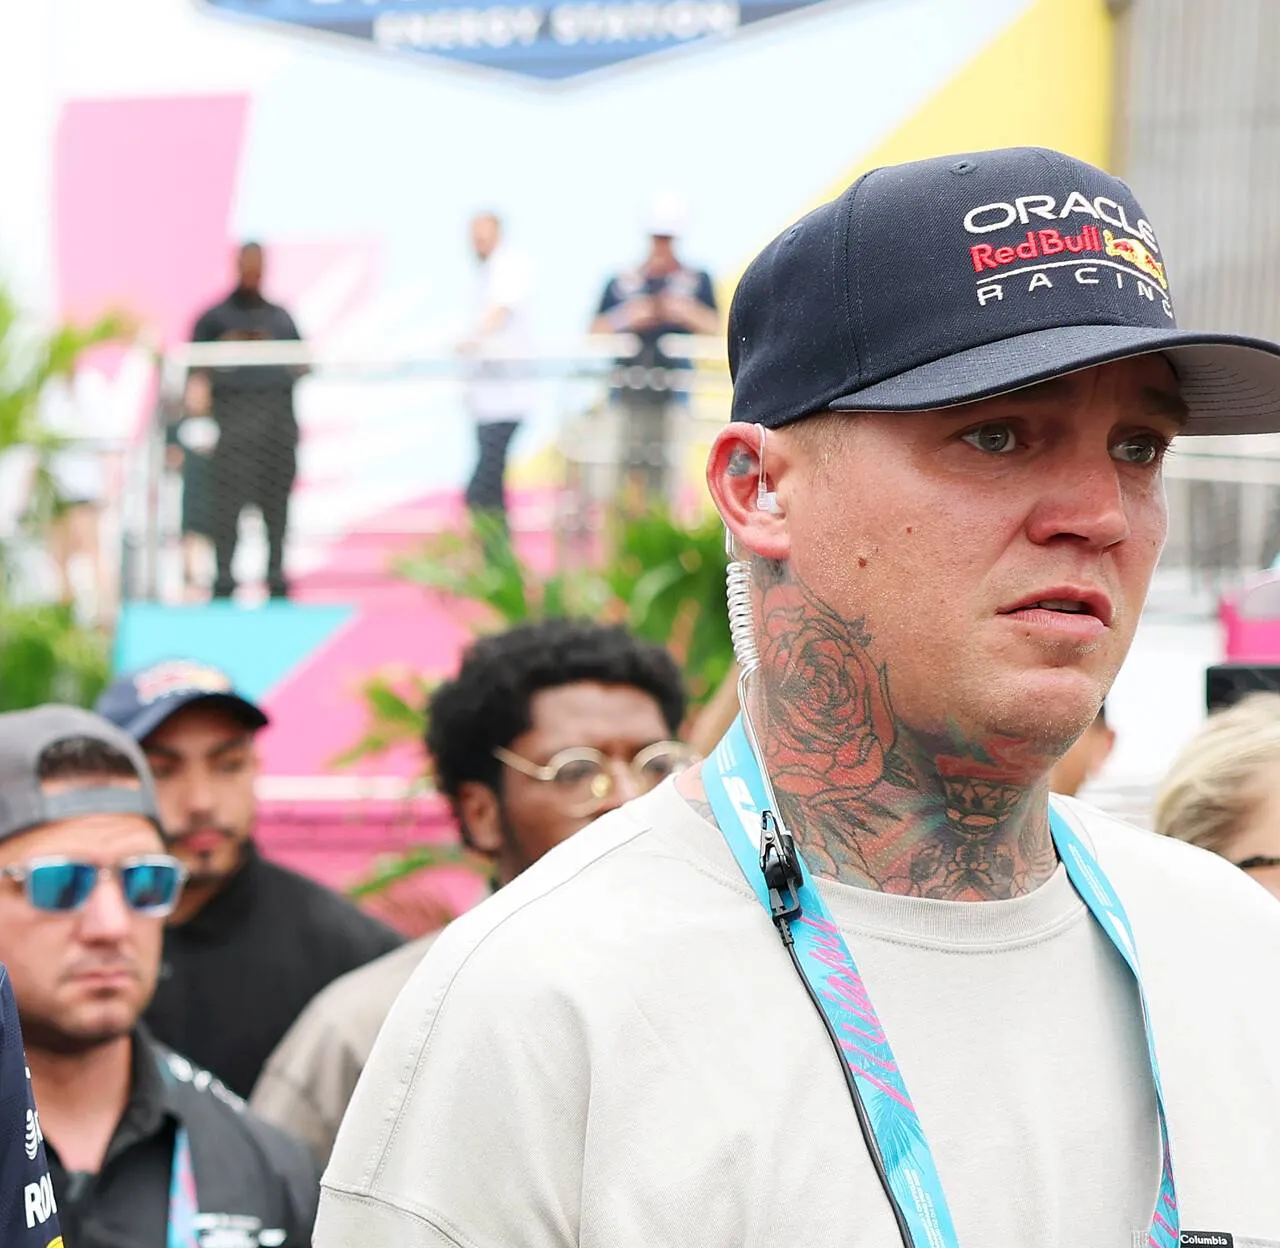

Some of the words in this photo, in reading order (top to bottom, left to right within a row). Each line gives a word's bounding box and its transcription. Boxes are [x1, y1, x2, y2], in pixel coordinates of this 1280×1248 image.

[963, 191, 1159, 253] ORACLE
[977, 266, 1173, 319] RACING
[1180, 1233, 1228, 1246] Columbia
